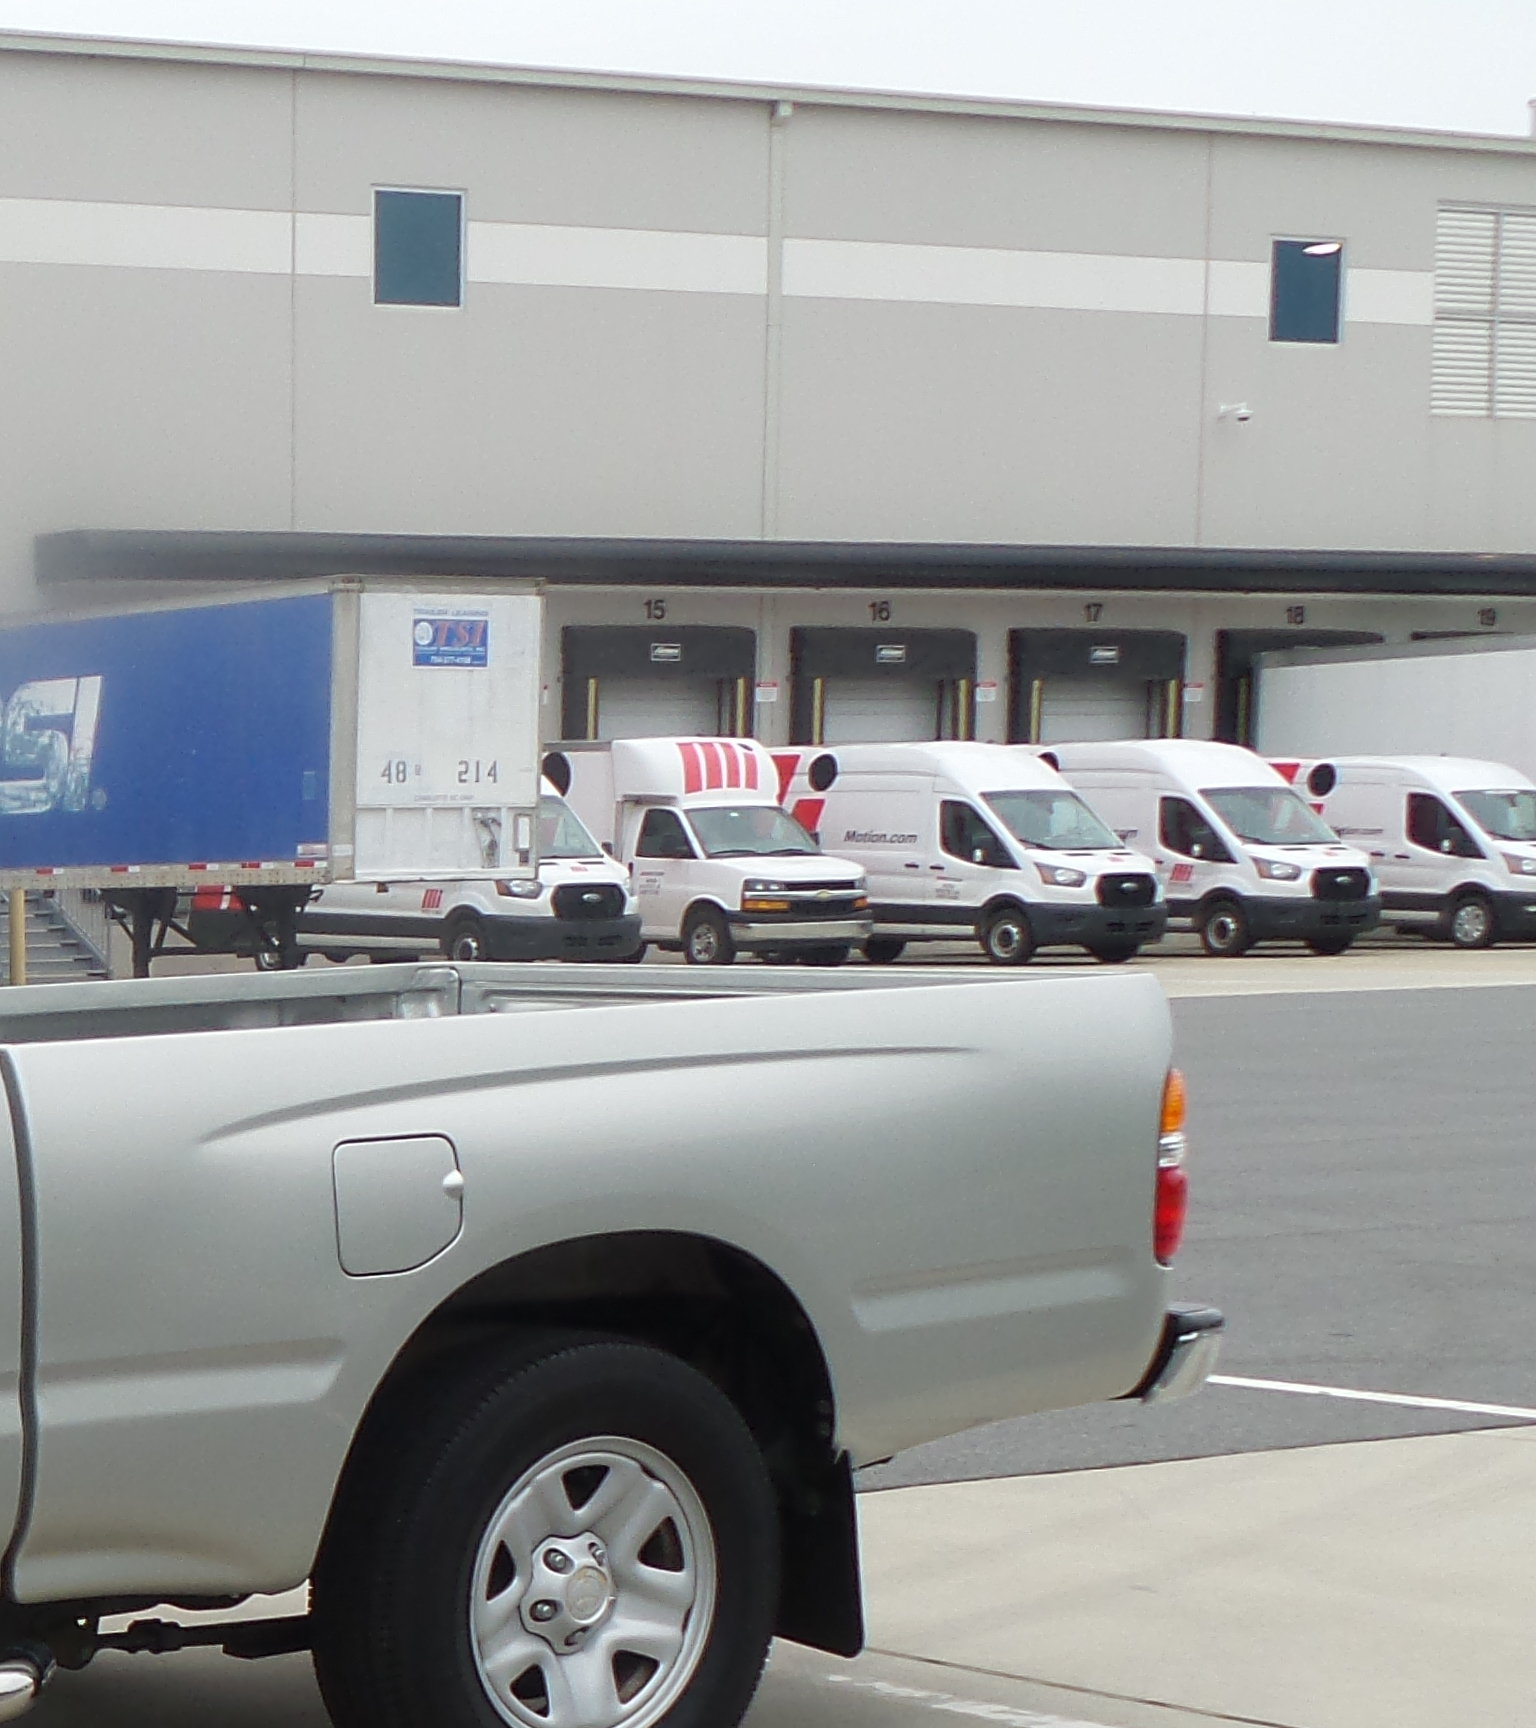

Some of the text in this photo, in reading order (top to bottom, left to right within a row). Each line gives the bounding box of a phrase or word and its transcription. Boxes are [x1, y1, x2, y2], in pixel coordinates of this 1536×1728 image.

[643, 599, 666, 620] 15
[868, 600, 891, 622] 16
[1084, 603, 1104, 623] 17
[1286, 605, 1305, 626] 18
[381, 759, 407, 784] 48
[458, 759, 498, 784] 214
[843, 830, 918, 844] Motion.com
